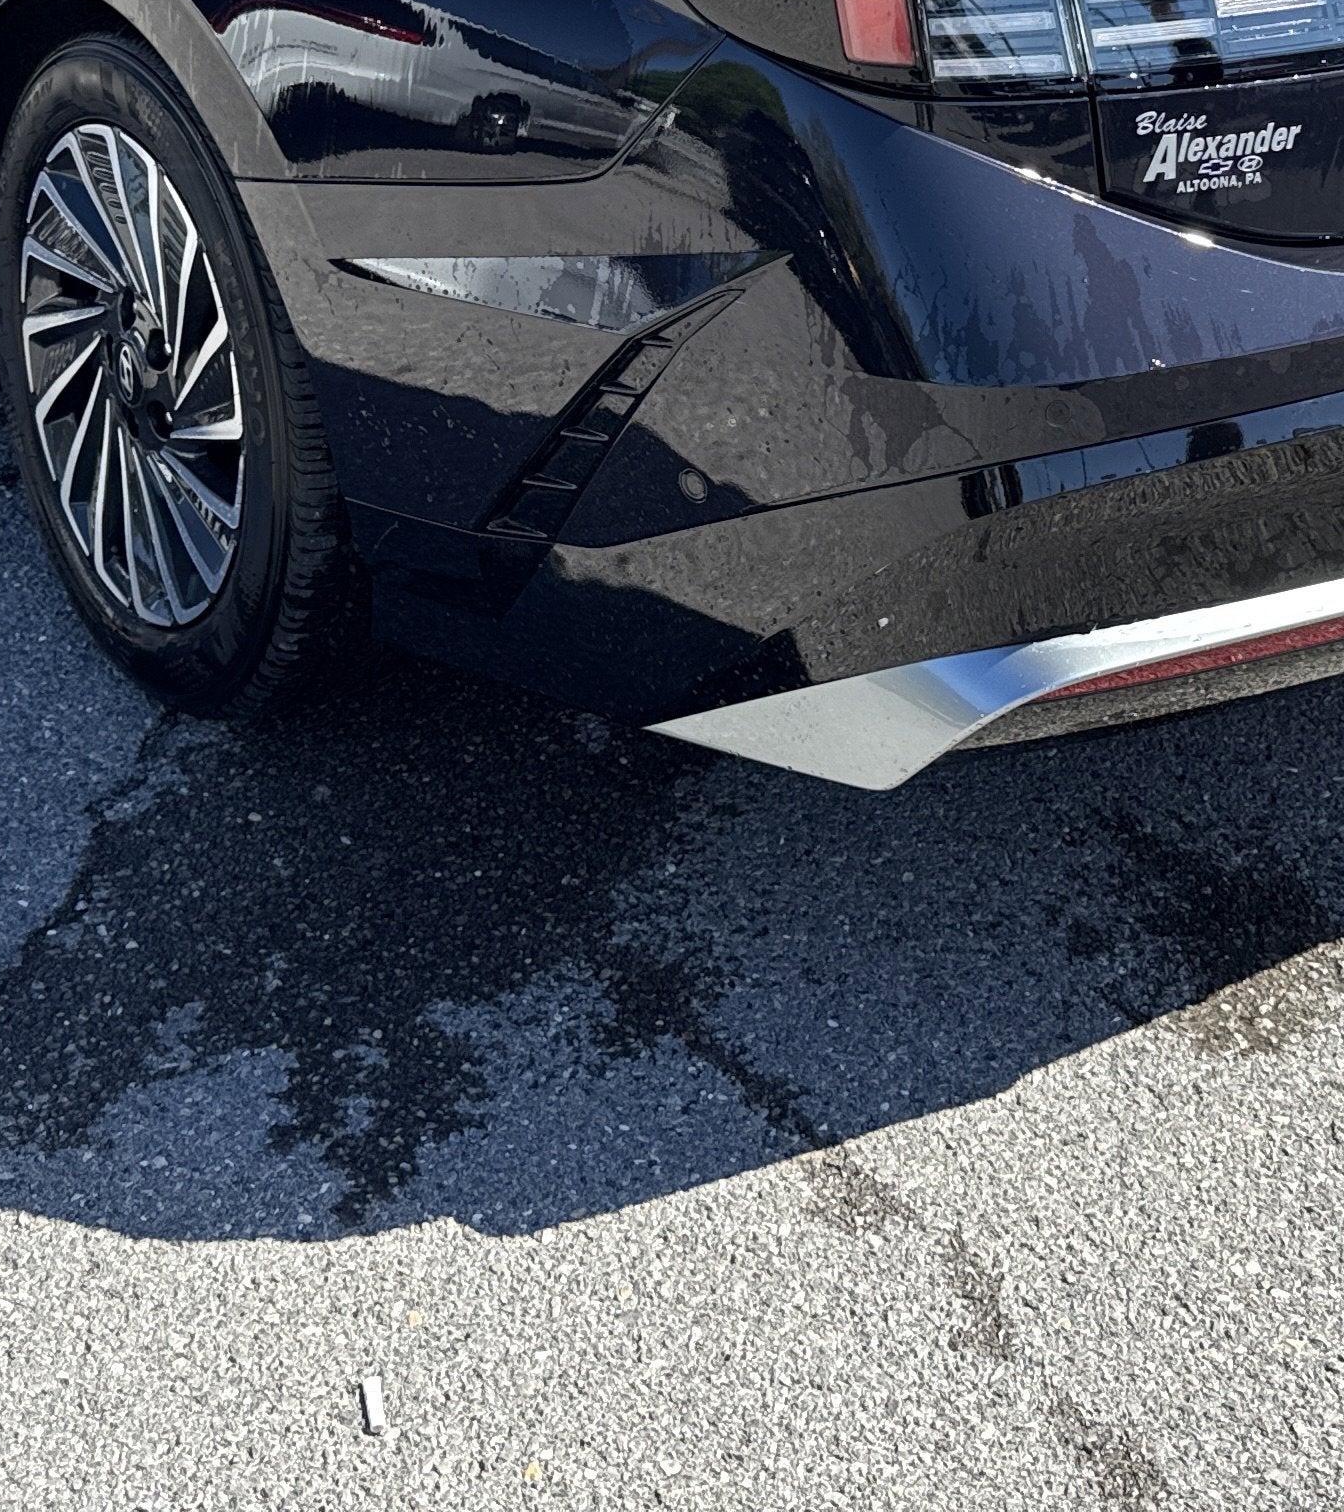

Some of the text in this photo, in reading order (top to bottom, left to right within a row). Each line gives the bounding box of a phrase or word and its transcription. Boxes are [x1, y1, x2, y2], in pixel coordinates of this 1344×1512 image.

[1135, 110, 1208, 136] Blaise
[1142, 122, 1303, 183] Alexander
[1175, 172, 1263, 194] ALTOONA, PA
